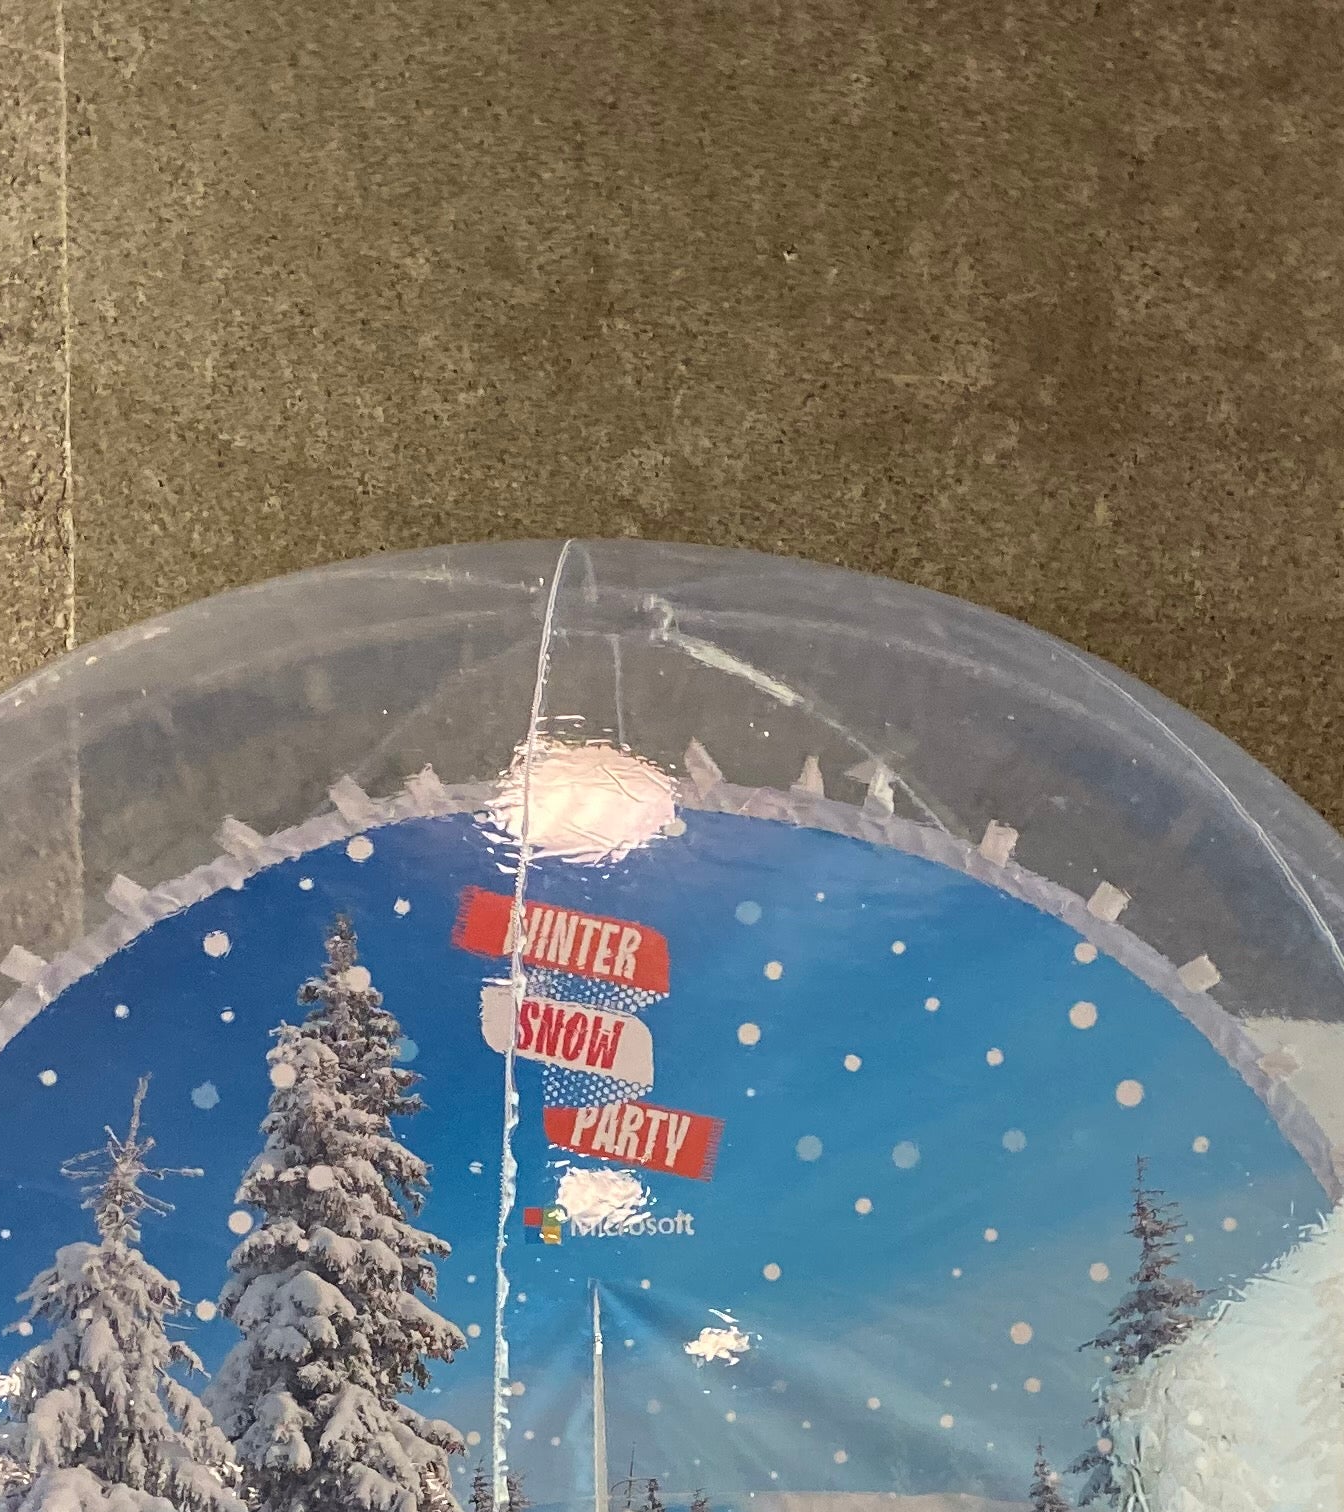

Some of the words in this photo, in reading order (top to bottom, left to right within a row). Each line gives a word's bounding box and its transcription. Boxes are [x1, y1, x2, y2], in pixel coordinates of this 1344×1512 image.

[503, 906, 643, 980] WINTER
[516, 1001, 624, 1069] SNOW
[570, 1103, 691, 1167] PARTY
